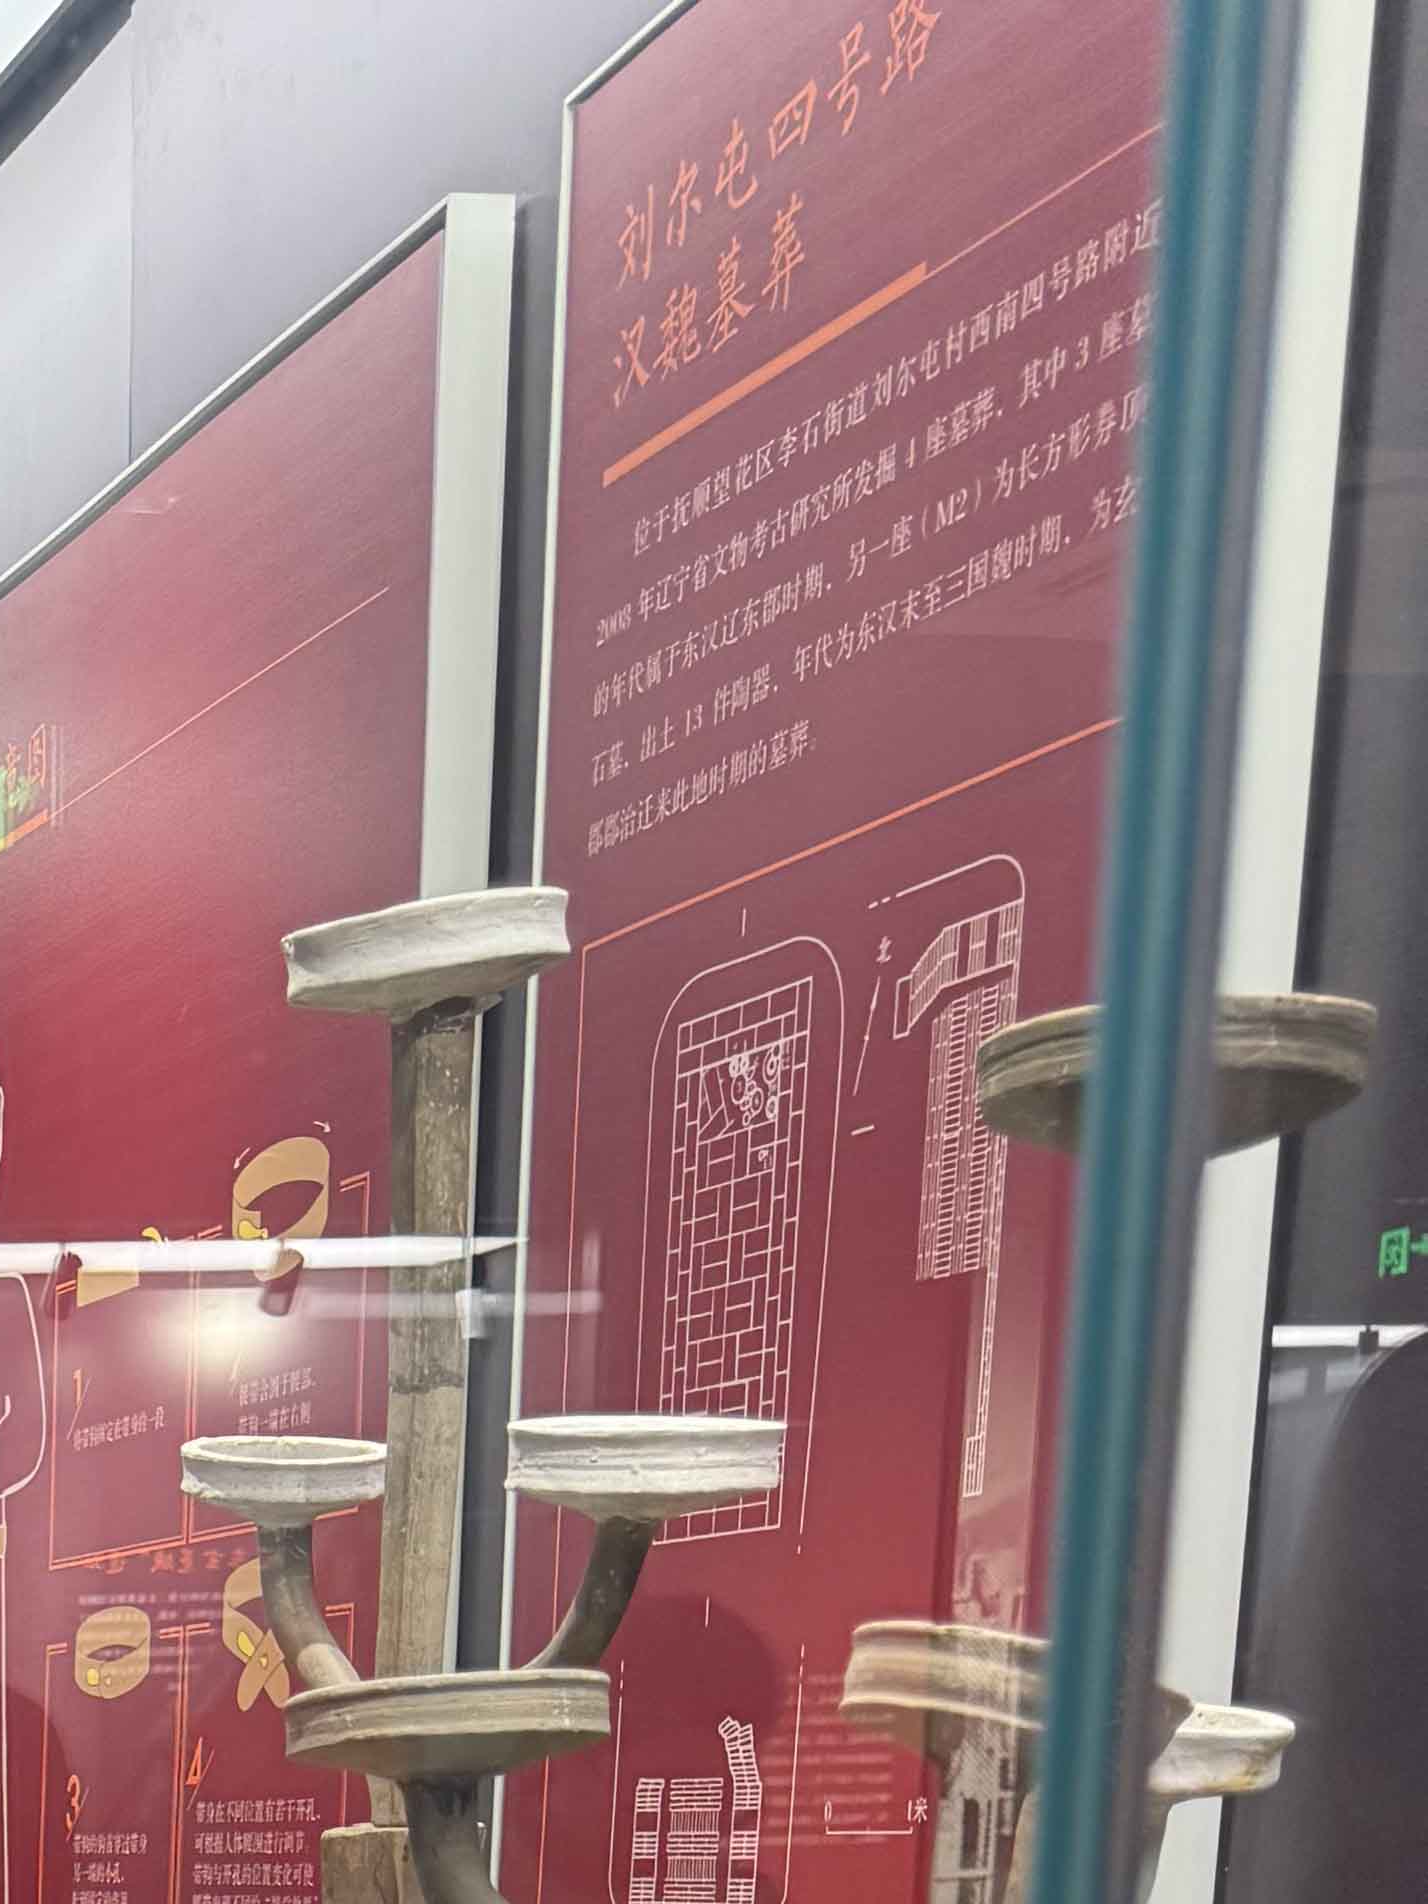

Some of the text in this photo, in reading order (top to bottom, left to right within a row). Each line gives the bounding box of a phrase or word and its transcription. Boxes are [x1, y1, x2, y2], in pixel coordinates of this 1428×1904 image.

[613, 190, 806, 409] 汉魏墓葬
[185, 1738, 203, 1786] 4
[65, 1774, 81, 1833] 3
